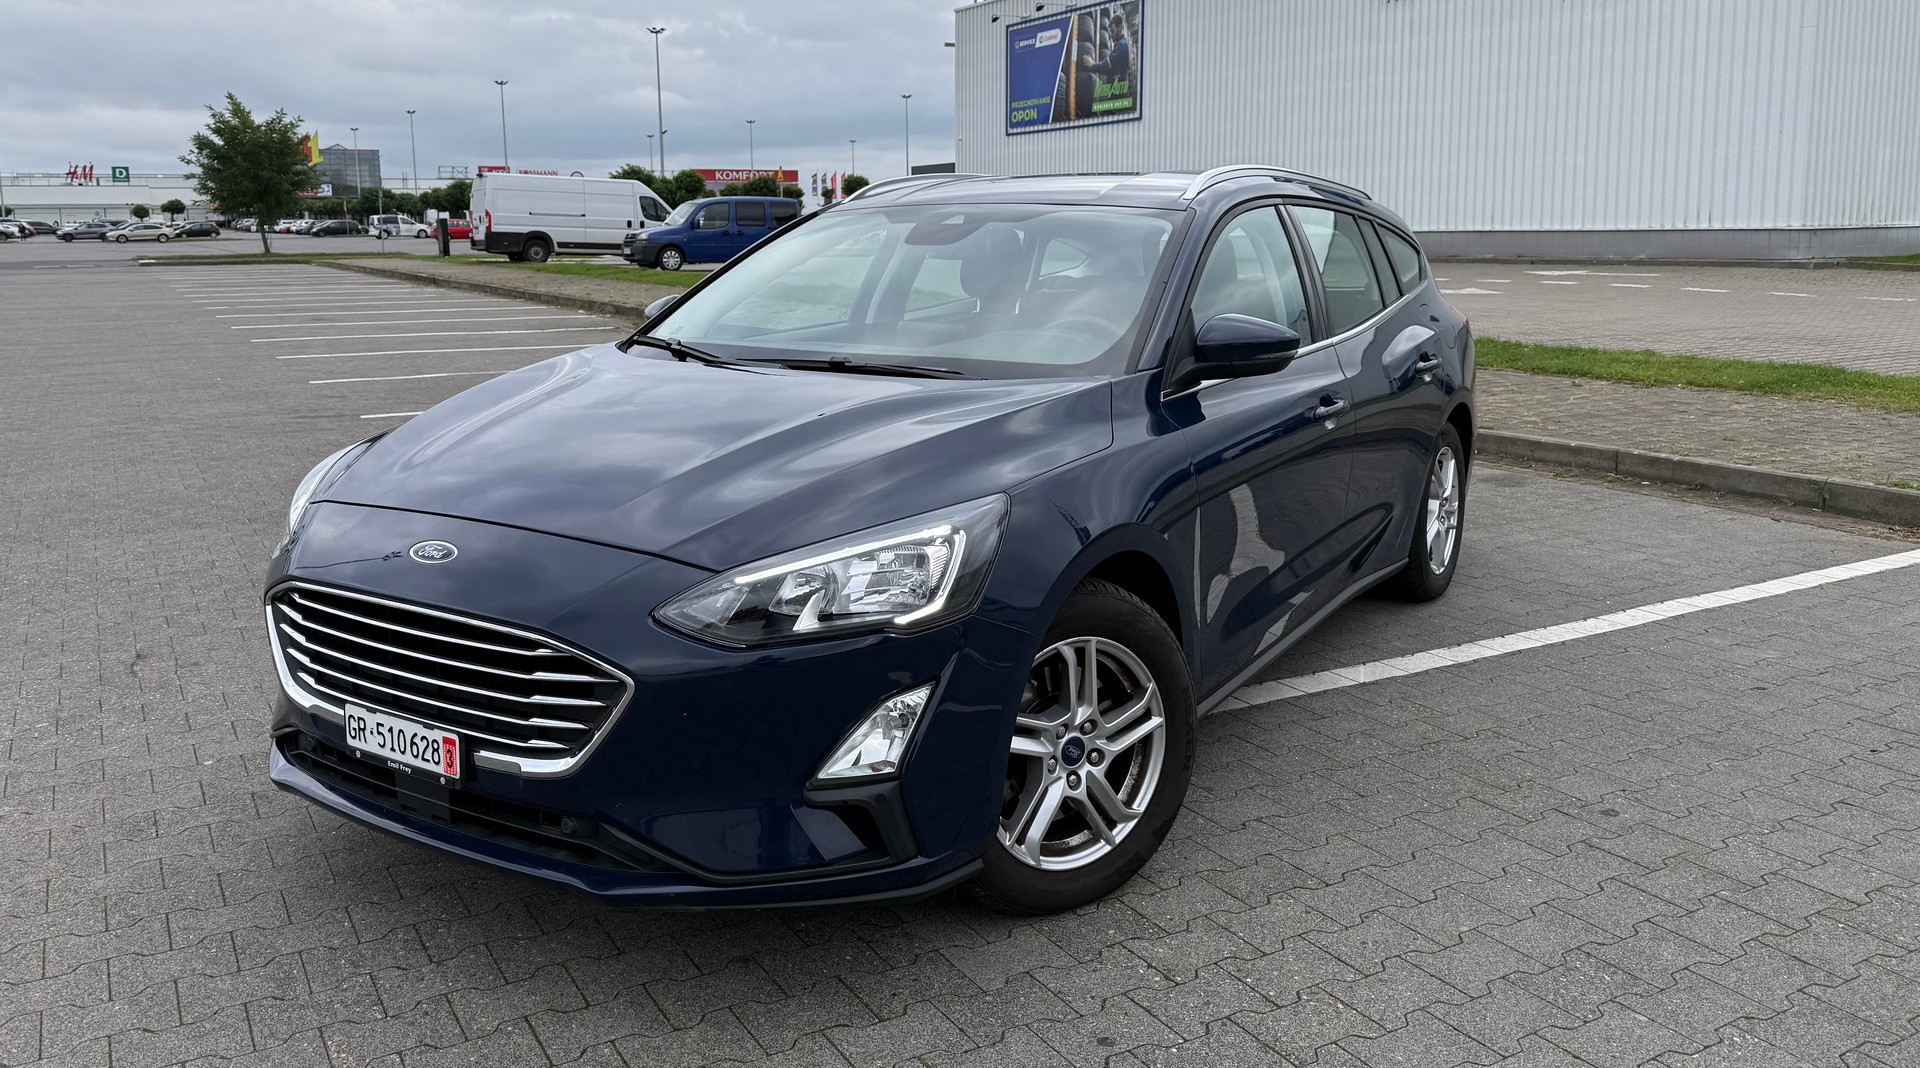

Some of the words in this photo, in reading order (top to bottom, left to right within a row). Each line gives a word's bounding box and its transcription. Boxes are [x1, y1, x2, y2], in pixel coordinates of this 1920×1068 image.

[1011, 95, 1051, 109] PRZECHOWANIE
[1011, 108, 1038, 123] OPON
[65, 164, 94, 183] H&M
[1182, 687, 1196, 772] NEXEN
[387, 760, 400, 770] Emil
[400, 763, 412, 774] Frey
